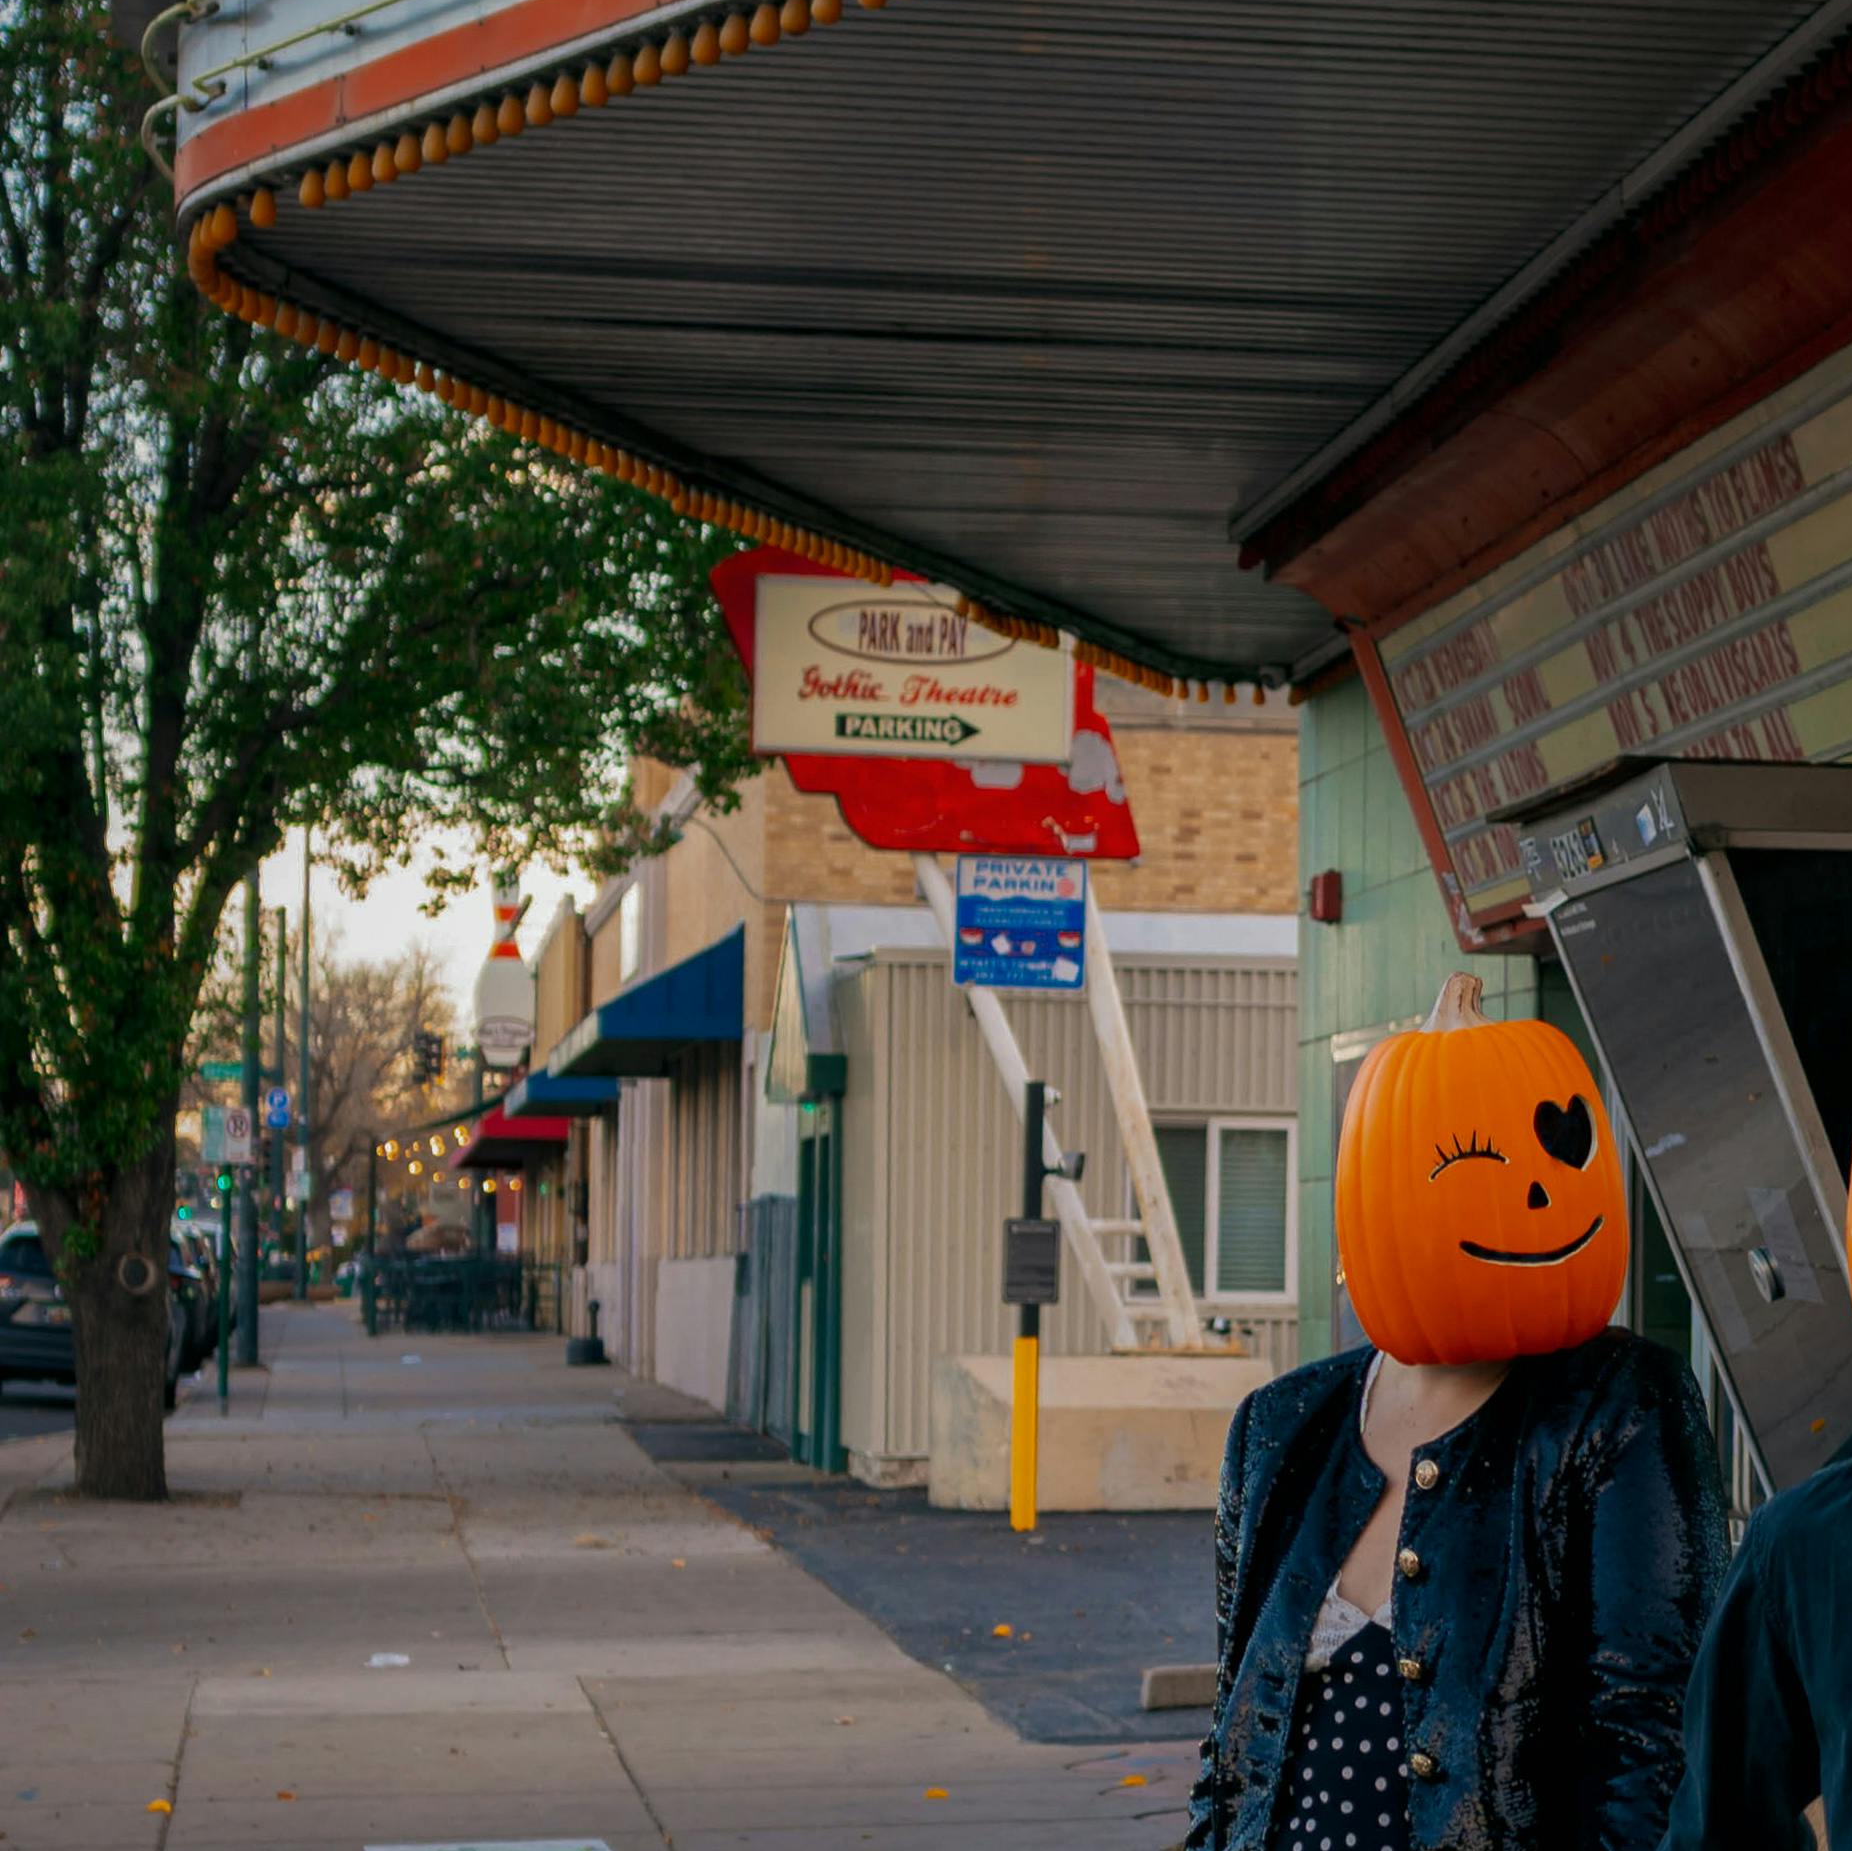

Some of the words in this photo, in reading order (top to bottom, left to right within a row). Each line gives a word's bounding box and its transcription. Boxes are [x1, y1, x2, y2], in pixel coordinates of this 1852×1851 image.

[1725, 540, 1781, 612] BOYS
[858, 611, 901, 651] PARK
[906, 620, 933, 654] and
[939, 614, 968, 658] PAY
[798, 663, 890, 702] Gothic
[899, 674, 1019, 707] Theatre
[845, 714, 963, 744] PARKING
[974, 876, 1056, 893] PARKIN
[975, 860, 1068, 877] PRIVATE
